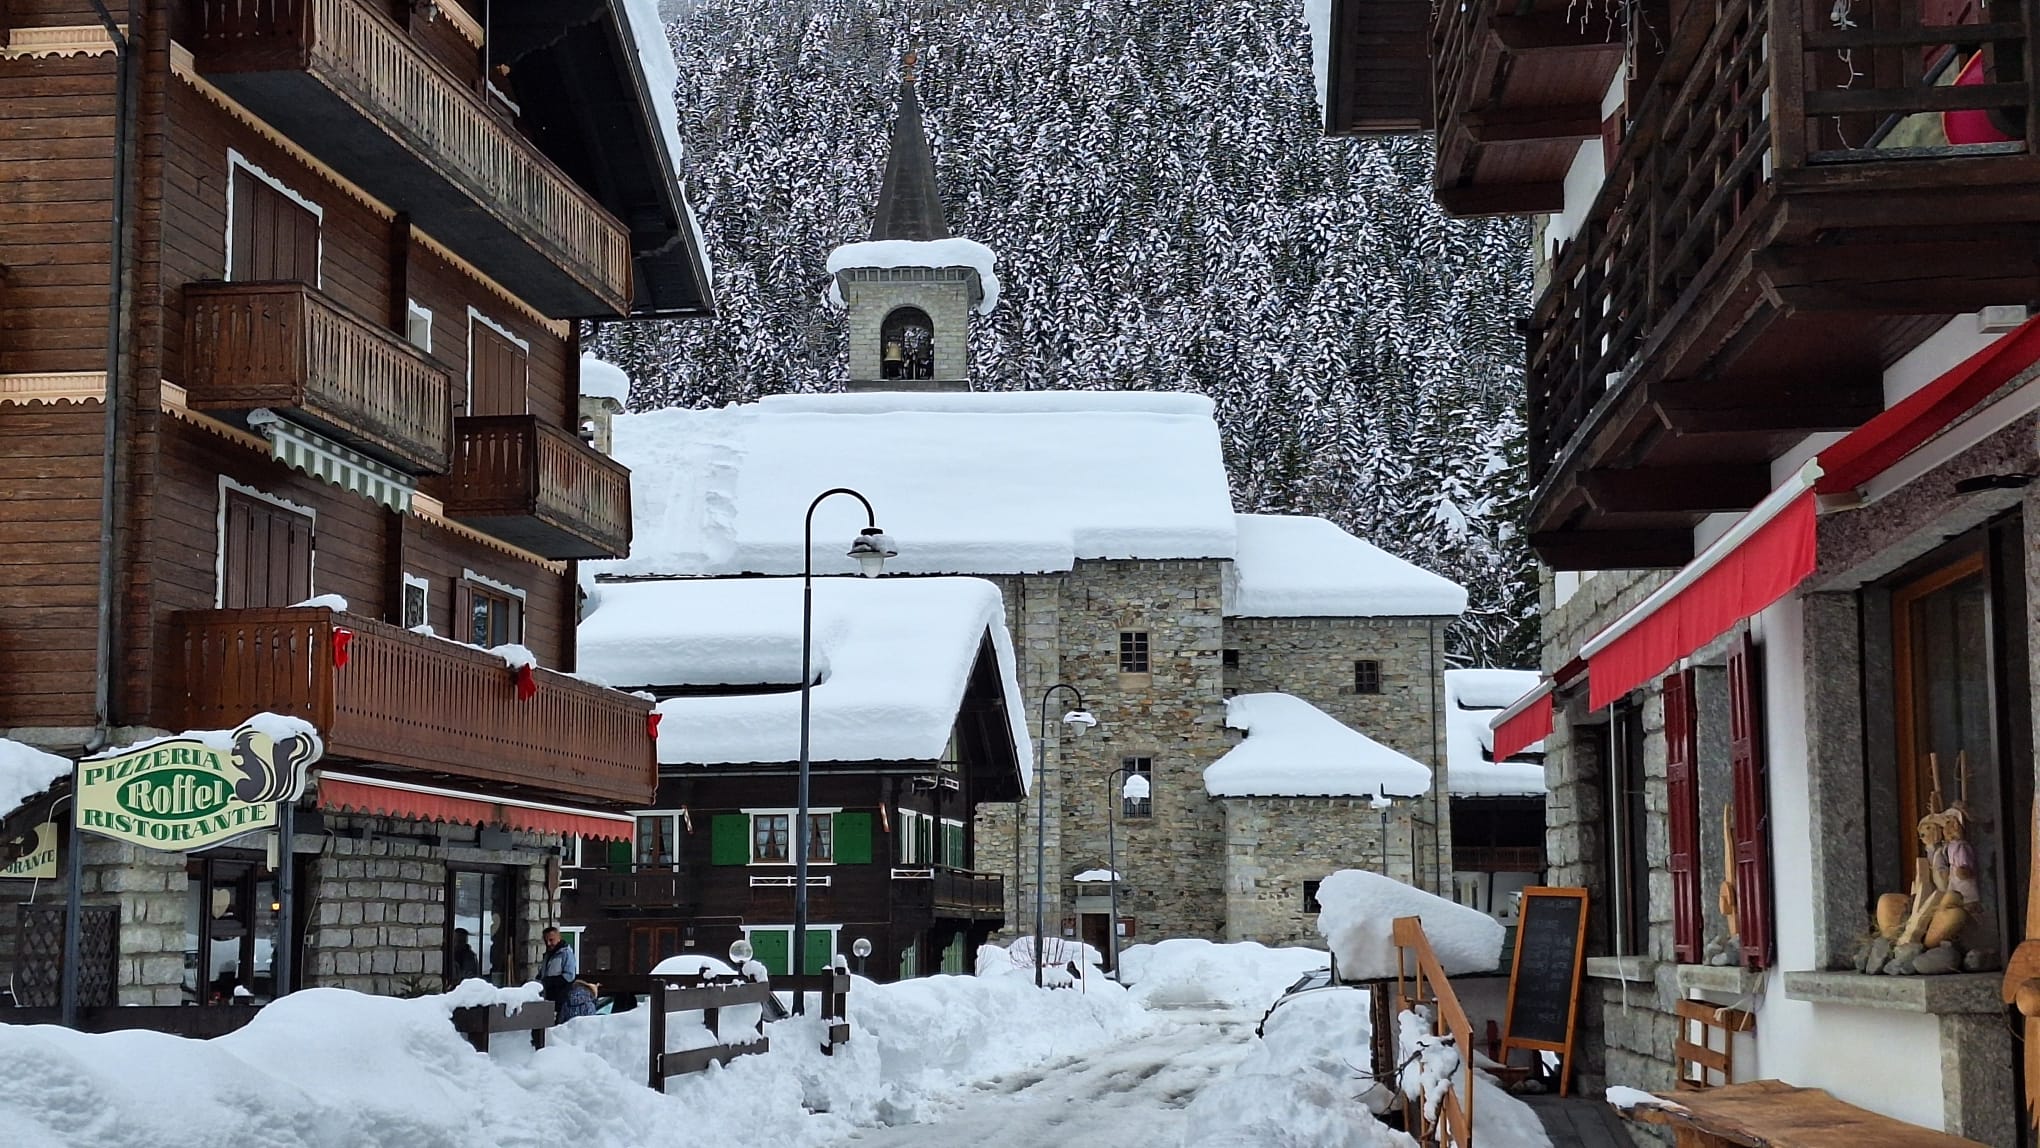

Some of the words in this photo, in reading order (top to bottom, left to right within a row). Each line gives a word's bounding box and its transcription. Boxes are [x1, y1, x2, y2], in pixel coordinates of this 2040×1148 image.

[85, 748, 223, 786] PIZZERIA
[127, 774, 223, 815] Roffel
[83, 803, 268, 841] RISTORANTE
